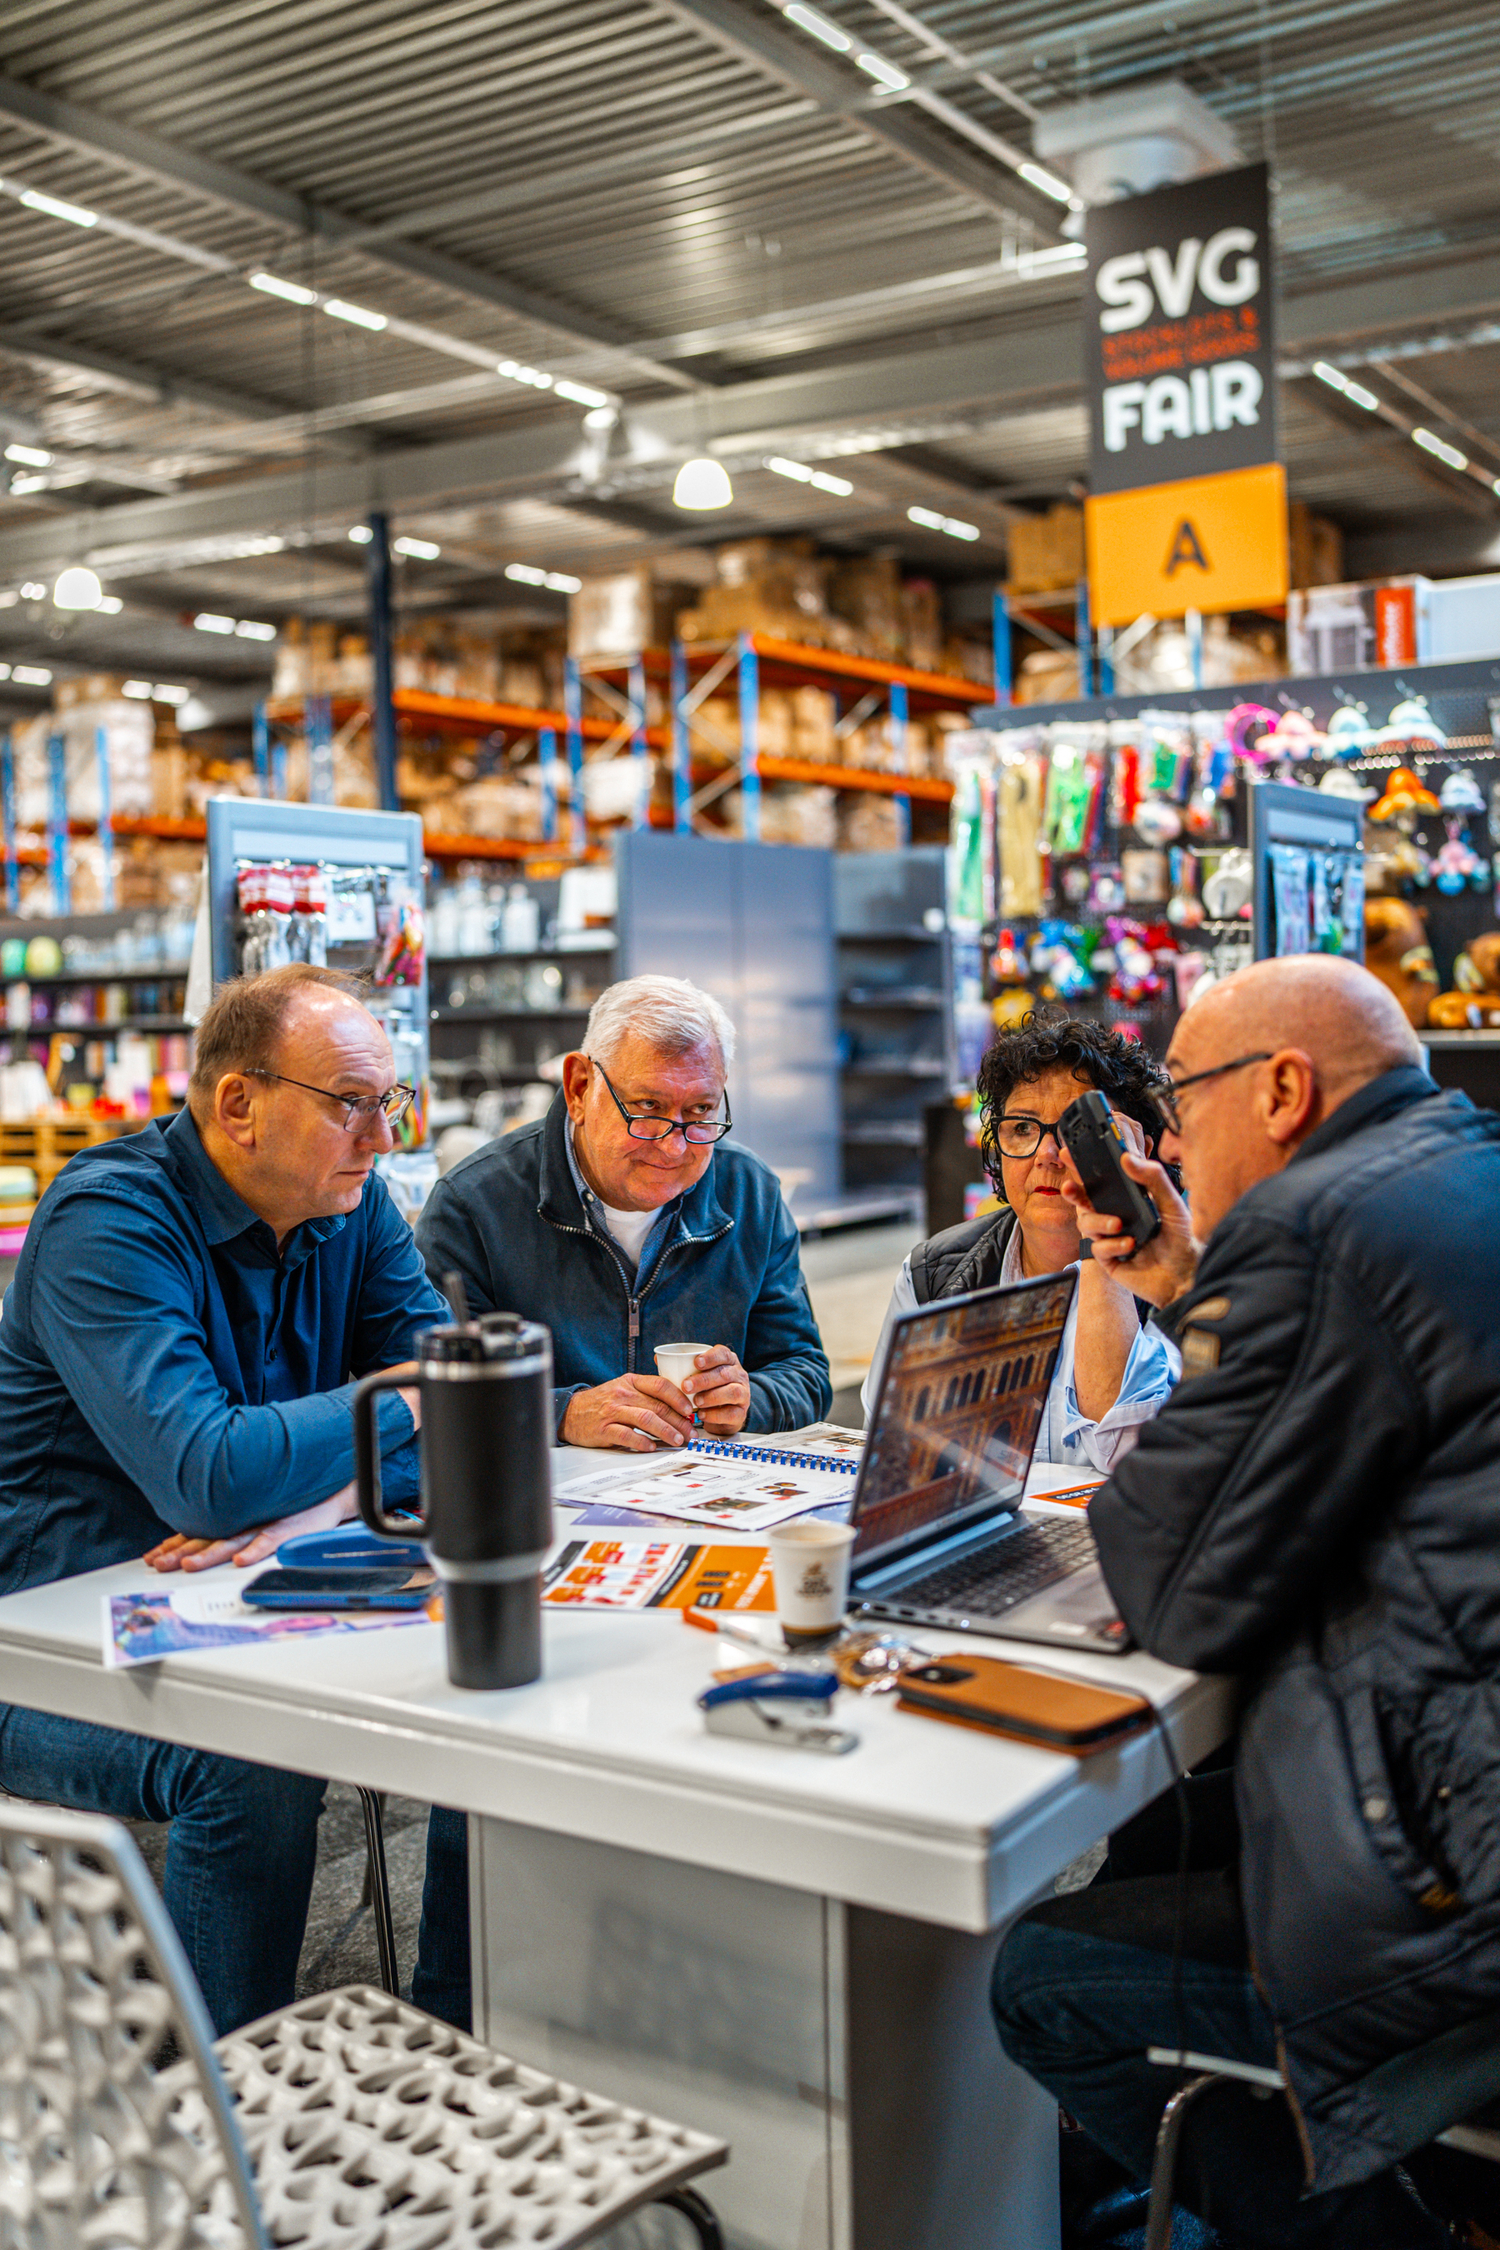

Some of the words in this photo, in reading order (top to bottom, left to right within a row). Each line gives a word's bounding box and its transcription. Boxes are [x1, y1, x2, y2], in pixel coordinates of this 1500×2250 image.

[1095, 227, 1260, 333] SVG
[1103, 360, 1263, 452] FAIR
[1164, 517, 1210, 576] A
